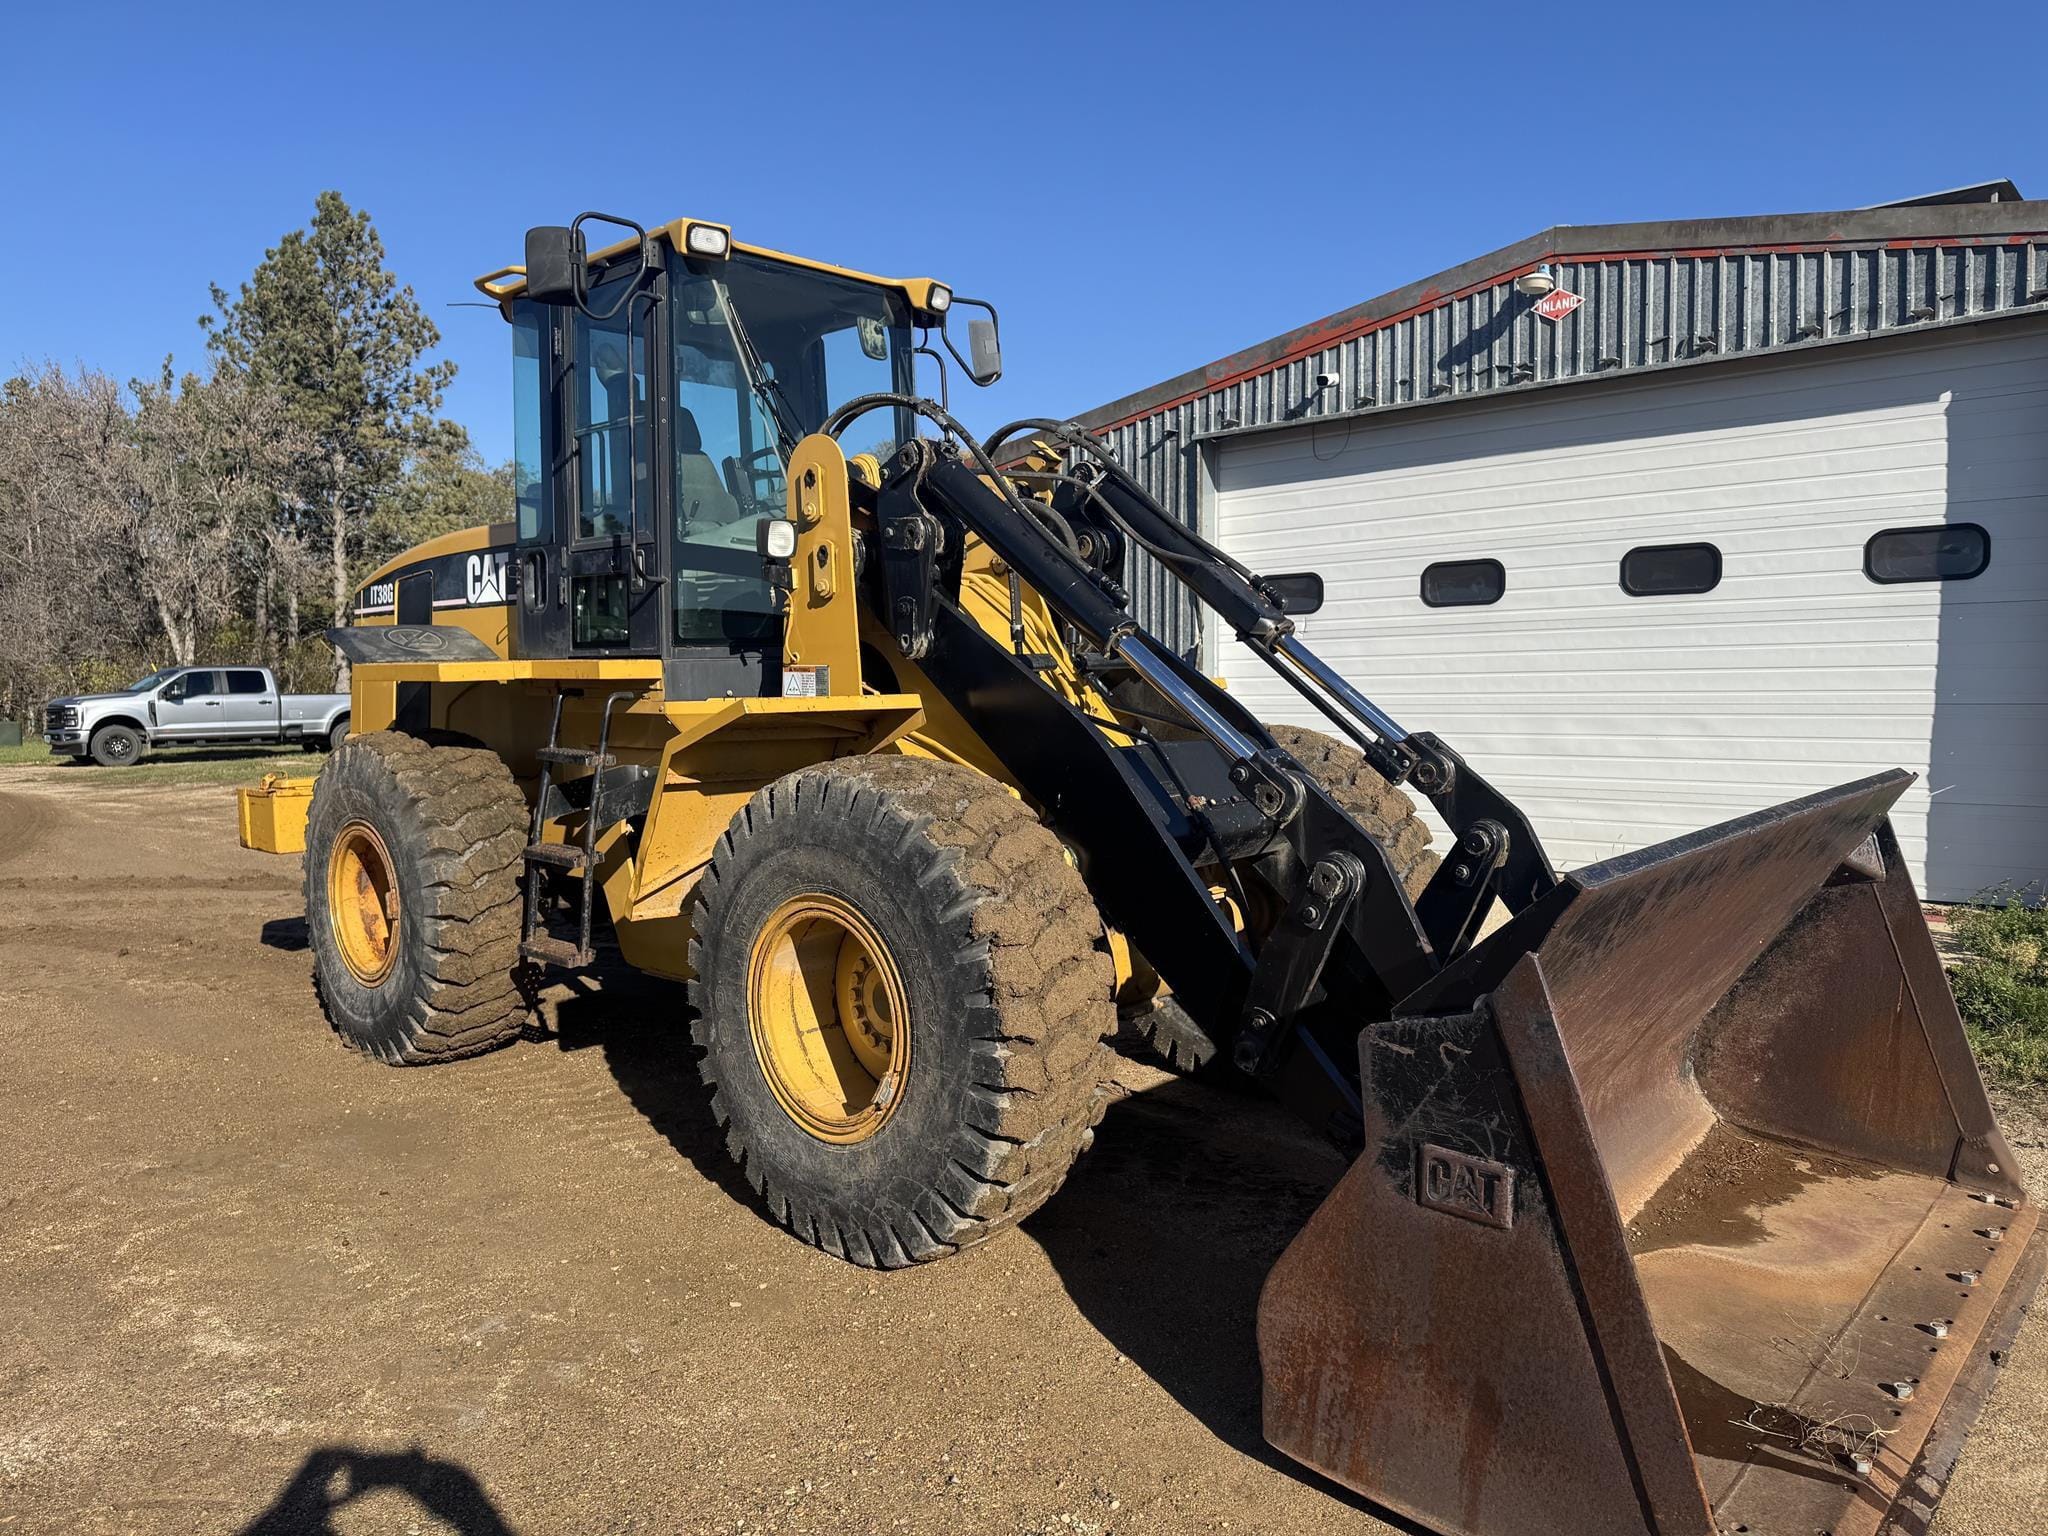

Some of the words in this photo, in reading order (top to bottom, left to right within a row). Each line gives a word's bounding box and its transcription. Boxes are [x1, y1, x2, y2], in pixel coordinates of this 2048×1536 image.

[1538, 296, 1577, 313] INLAND
[370, 583, 394, 605] IT38G
[467, 552, 509, 604] CAT
[1426, 1157, 1501, 1219] CAT
